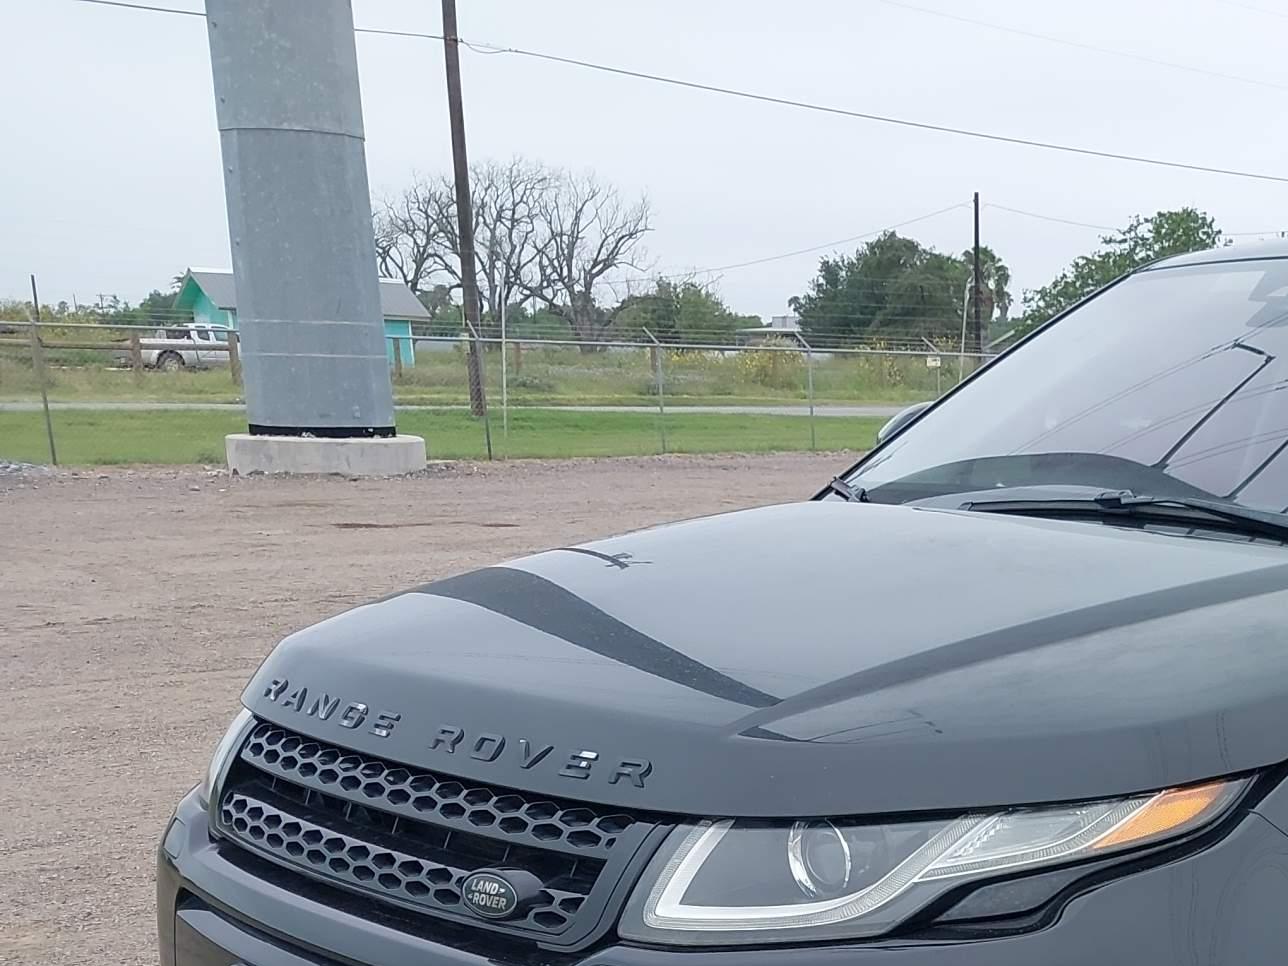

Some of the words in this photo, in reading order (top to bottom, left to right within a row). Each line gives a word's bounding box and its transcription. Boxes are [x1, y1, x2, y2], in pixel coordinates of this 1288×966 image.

[263, 677, 402, 738] RANGE
[428, 723, 653, 788] ROVER
[471, 878, 499, 895] LAND
[472, 893, 507, 910] ROVER
